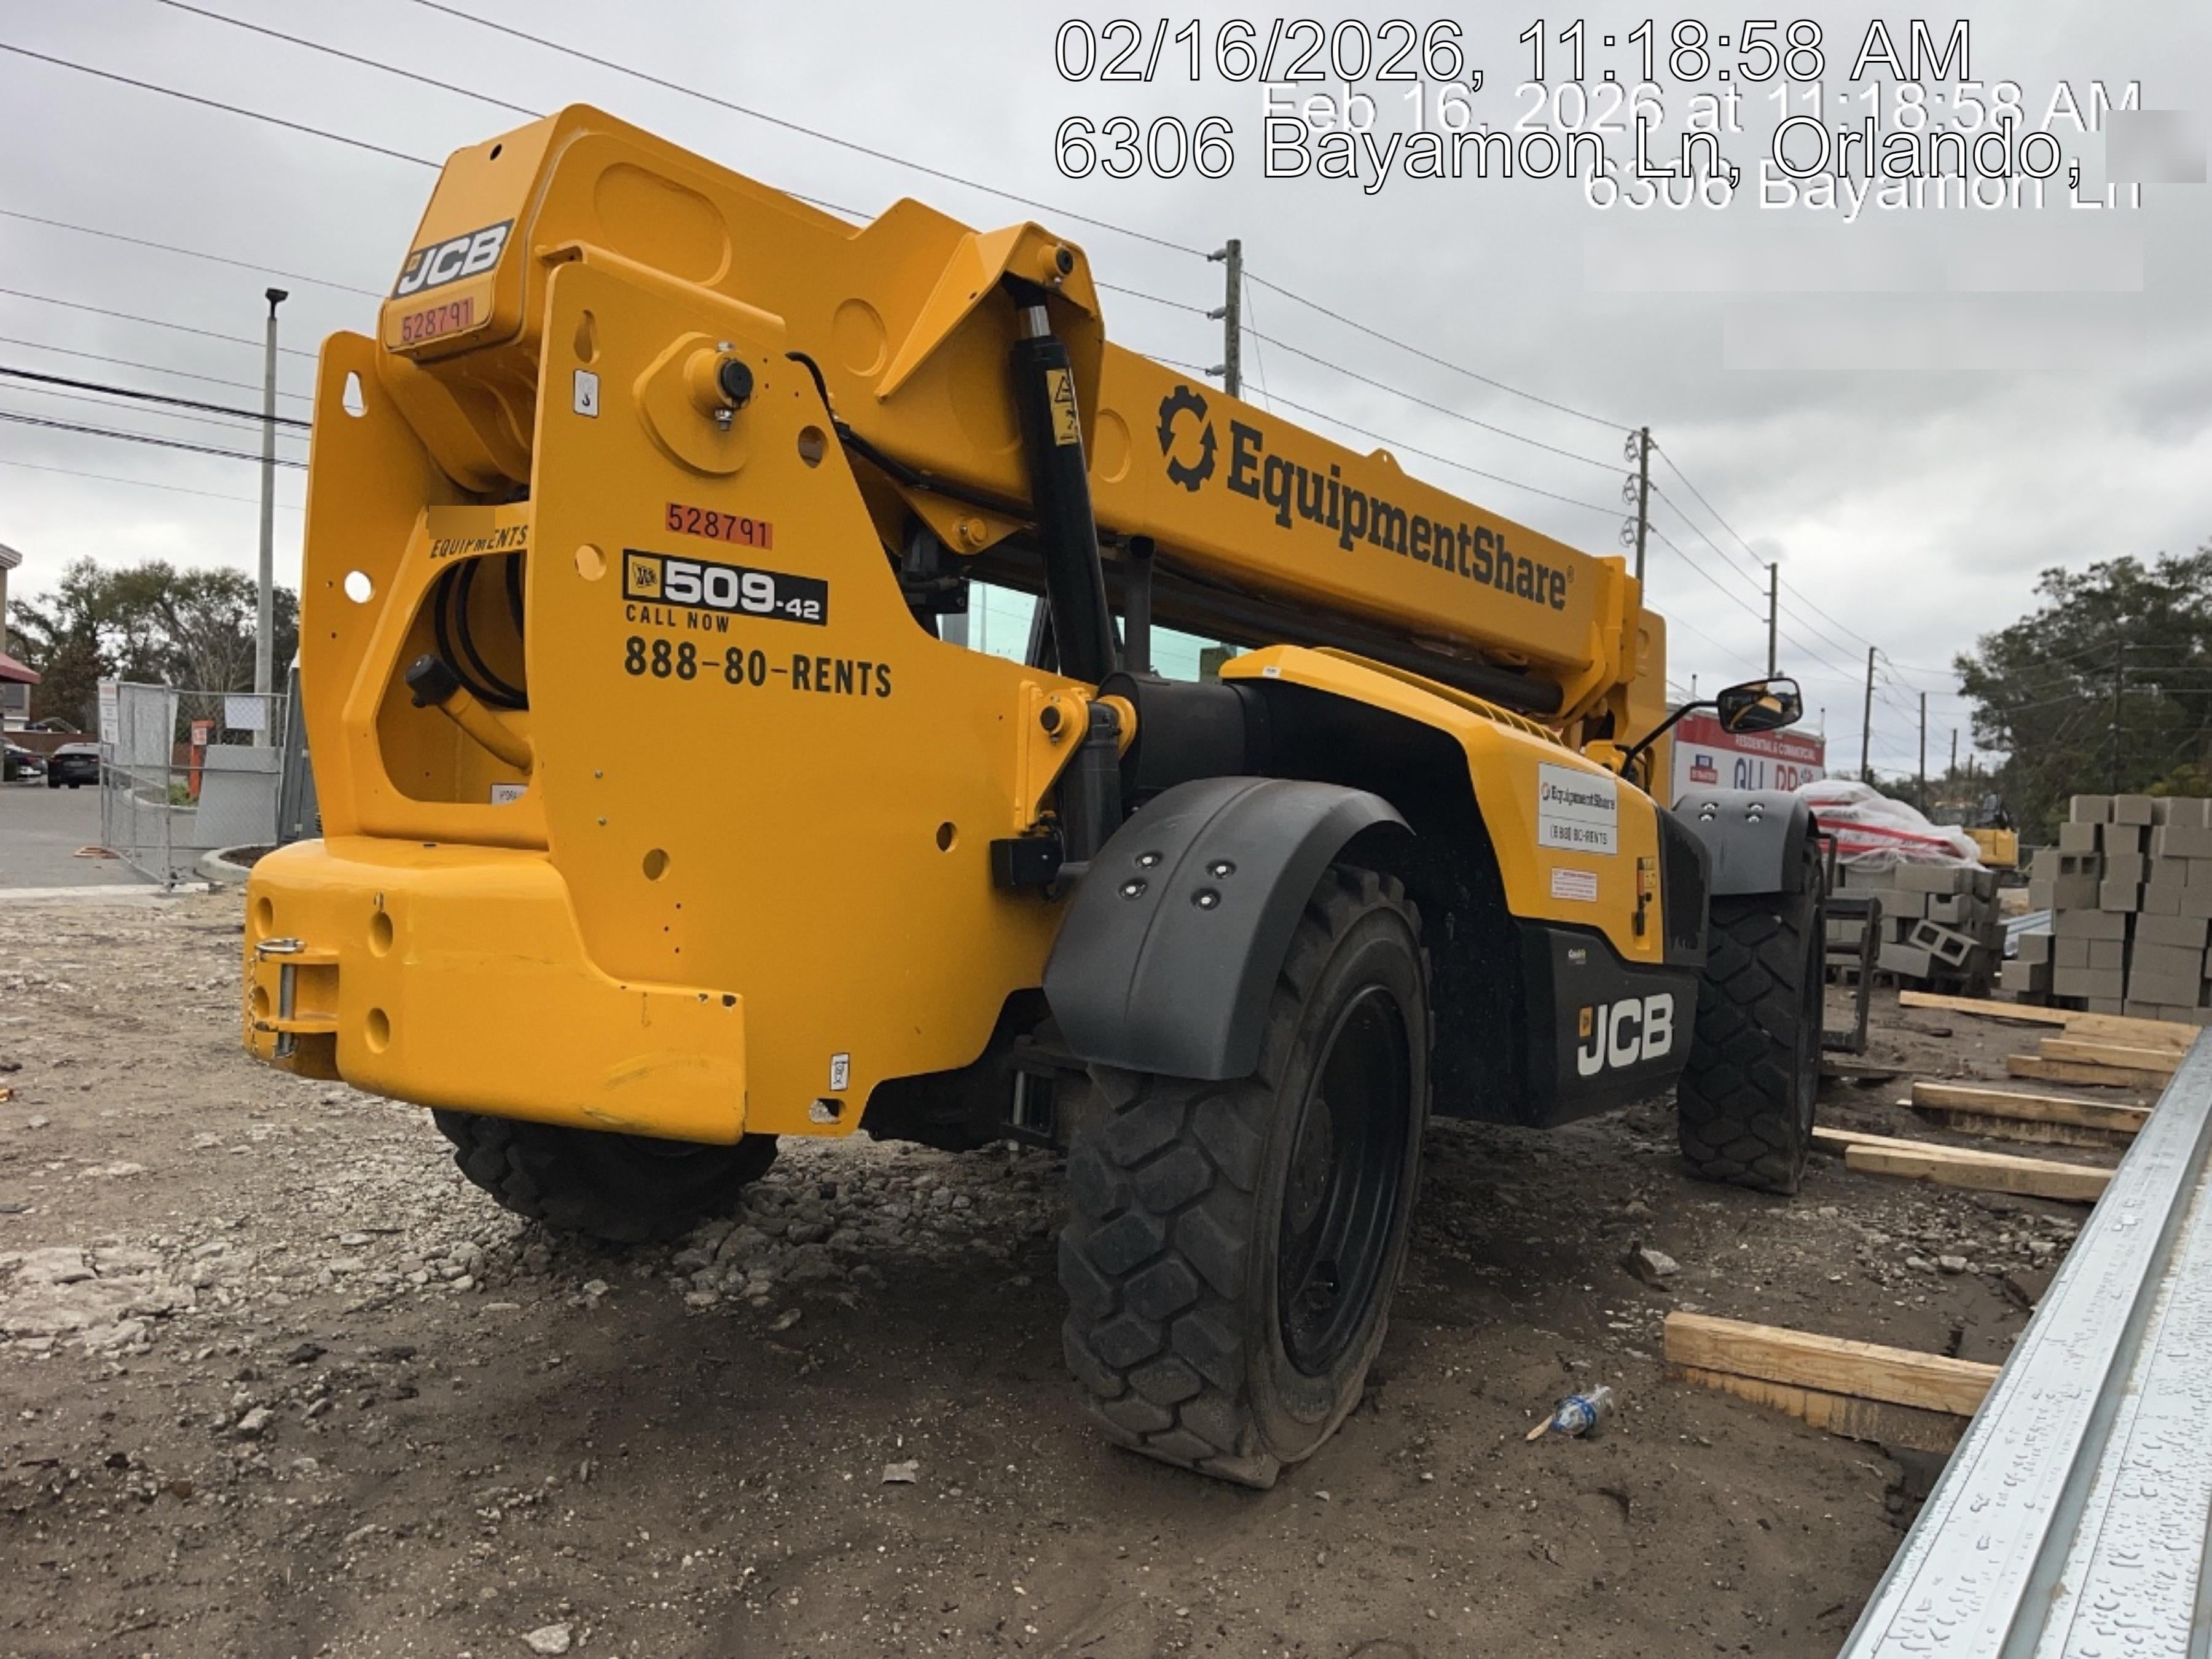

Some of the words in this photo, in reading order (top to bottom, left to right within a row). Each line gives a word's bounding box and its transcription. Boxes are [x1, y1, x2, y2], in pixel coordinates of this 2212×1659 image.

[398, 225, 508, 294] JCB
[402, 299, 470, 342] 528791
[668, 503, 767, 547] 528791
[1228, 419, 1566, 611] EquipmentShare
[626, 604, 677, 627] CALL
[688, 611, 729, 633] NOW
[665, 560, 820, 620] 509-42
[624, 635, 892, 698] 888-80-RENTS
[1551, 785, 1615, 810] EquipmentShare
[1577, 993, 1674, 1075] JCB
